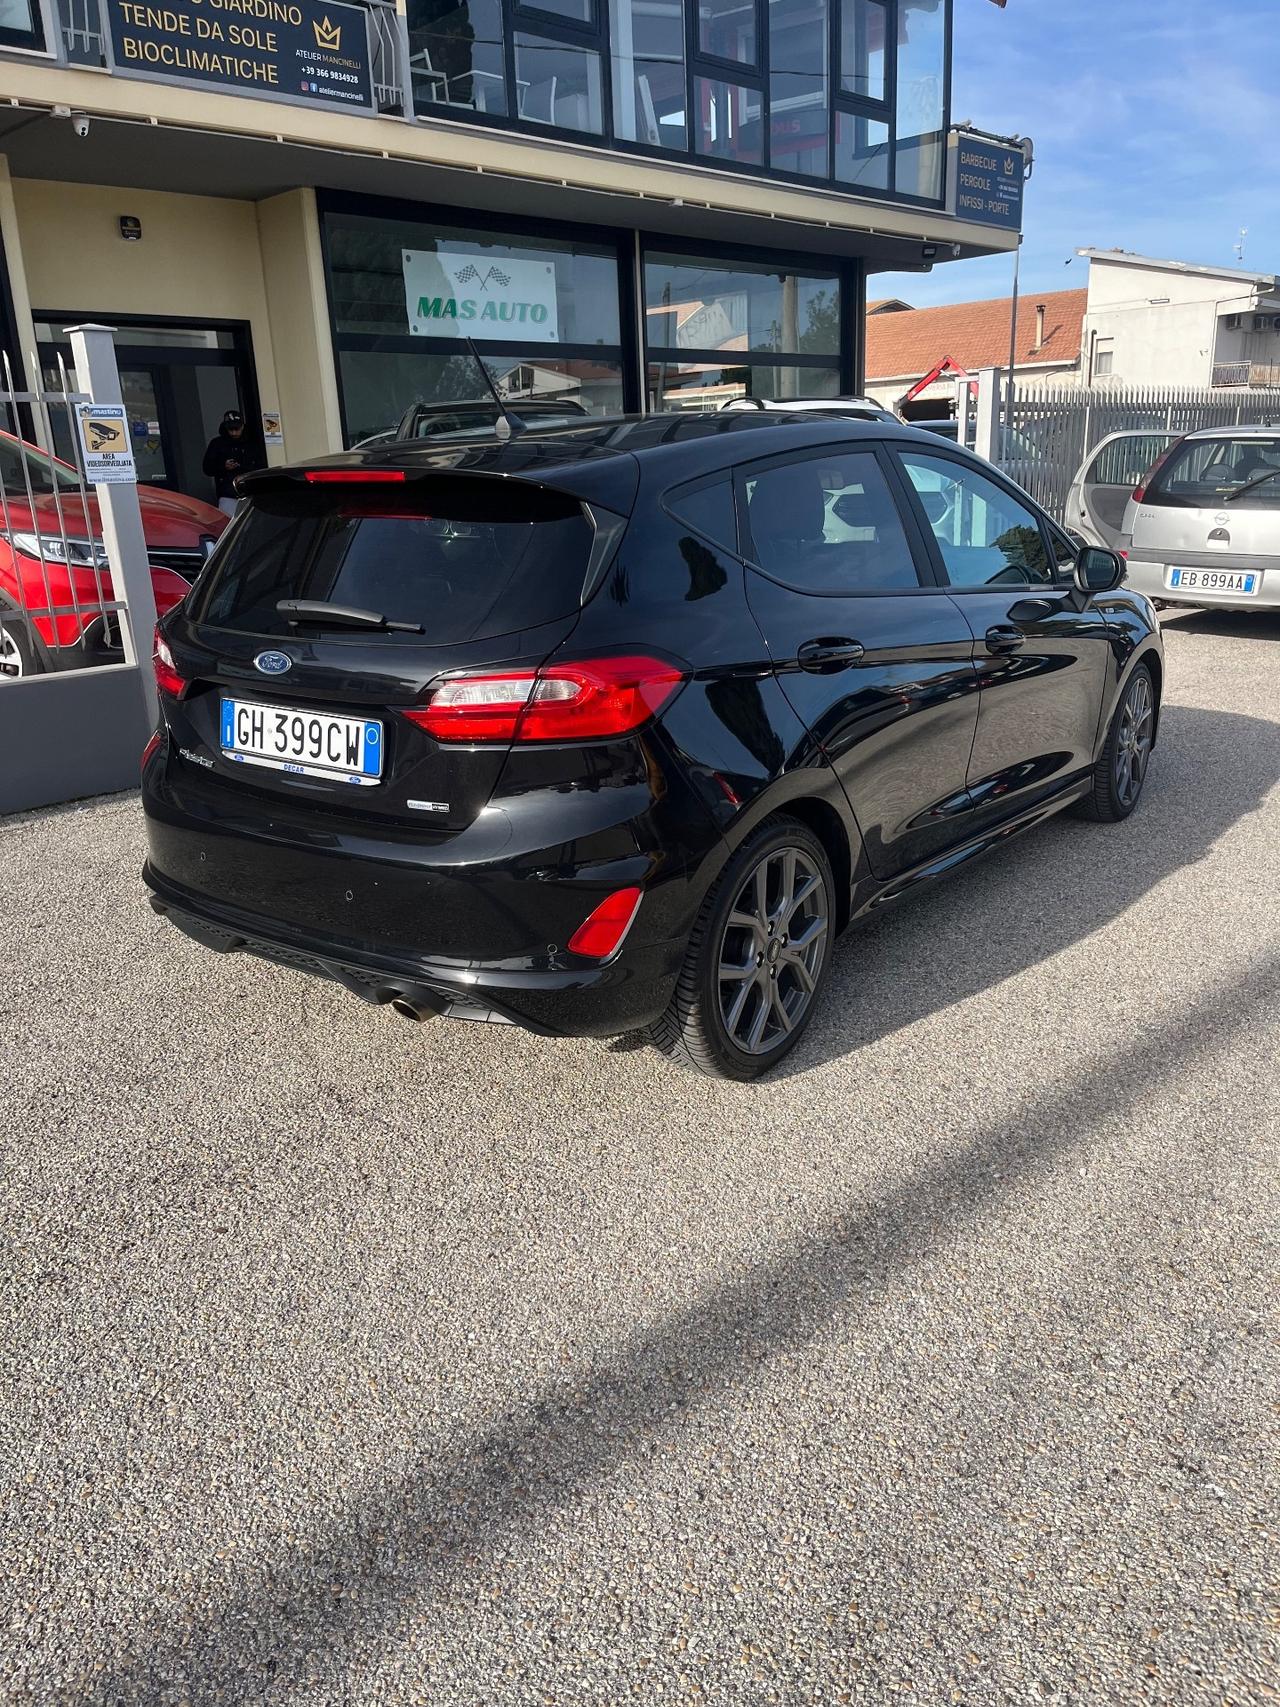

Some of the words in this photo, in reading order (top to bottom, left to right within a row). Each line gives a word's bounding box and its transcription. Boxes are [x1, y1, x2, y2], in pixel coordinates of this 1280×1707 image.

[118, 2, 192, 36] TENDE
[195, 18, 225, 42] DA
[228, 25, 279, 53] SOLE
[122, 37, 279, 84] BIOCLIMATICHE
[295, 49, 322, 61] ATELIER
[322, 55, 361, 69] MANCINELLI
[301, 65, 315, 75] +39
[316, 68, 329, 78] 366
[960, 152, 997, 171] BARBECUE
[960, 173, 991, 191] PERGOLE
[959, 194, 984, 210] INFISSI
[988, 200, 1010, 216] PORTE
[416, 296, 476, 321] MAS
[480, 301, 548, 325] AUTO
[1180, 571, 1198, 586] EB
[1201, 573, 1243, 589] 899AA
[237, 708, 264, 749] GH
[274, 713, 360, 767] 399CW
[283, 763, 304, 774] DECAR
